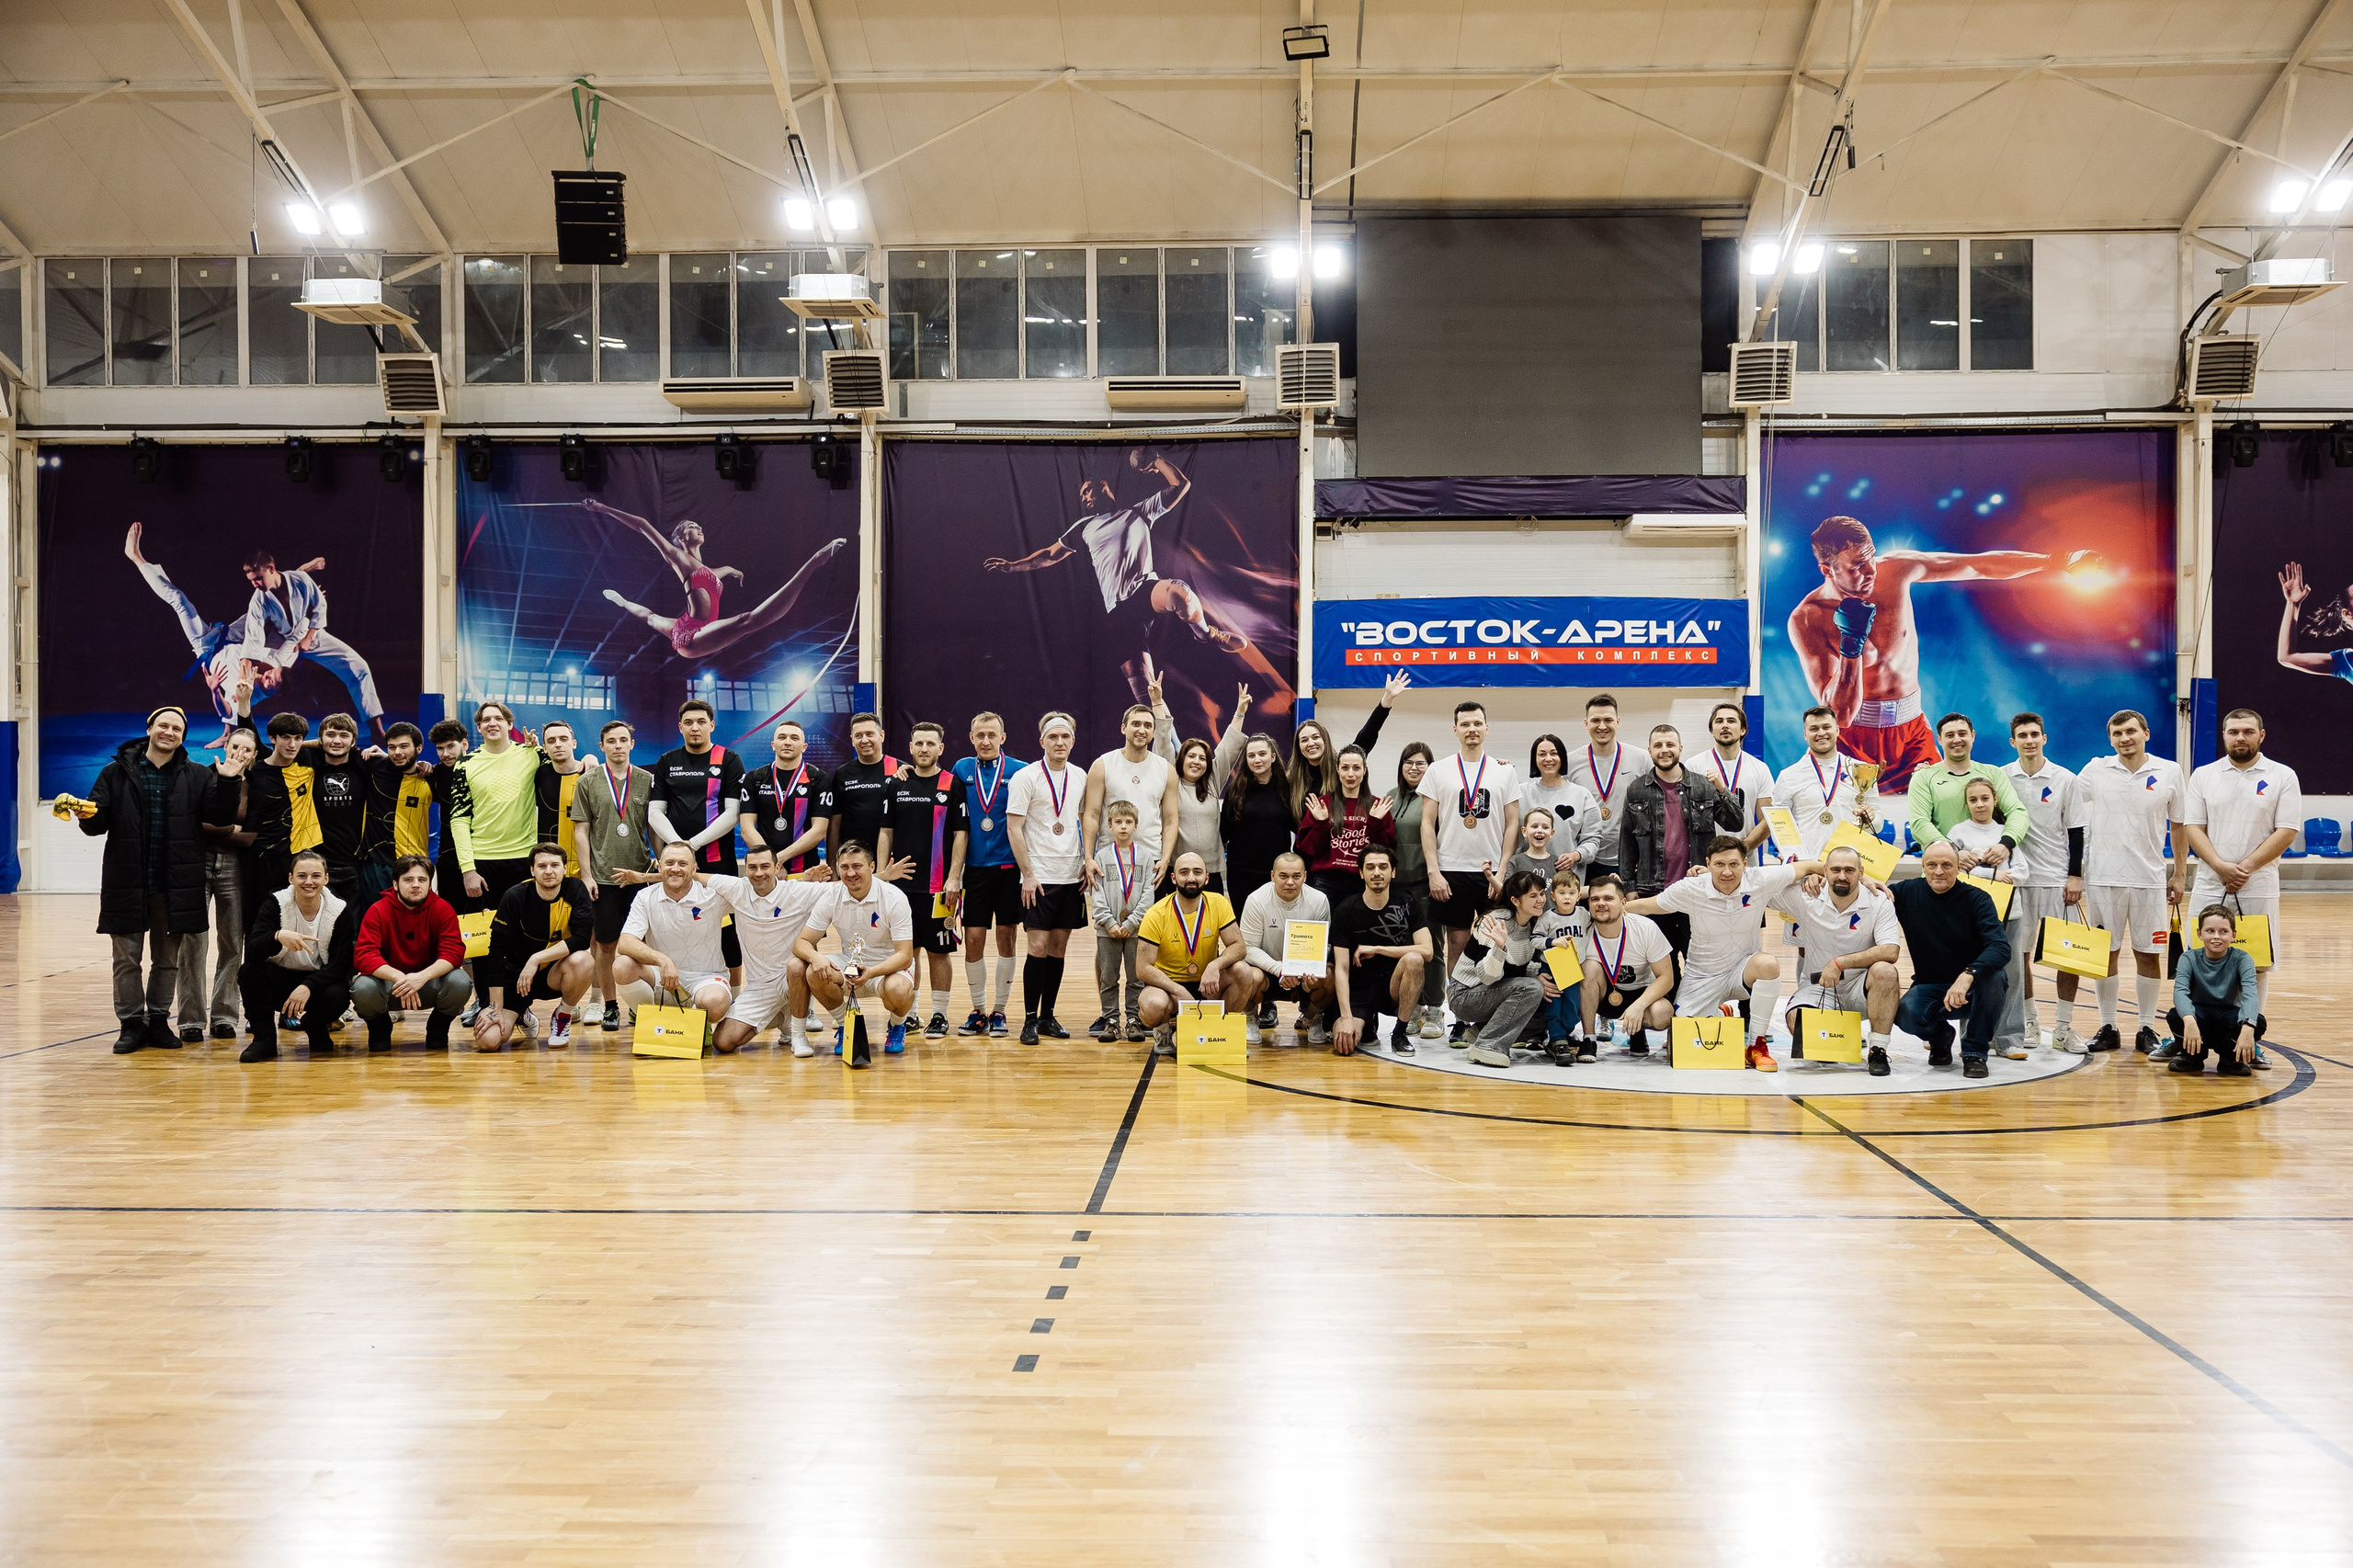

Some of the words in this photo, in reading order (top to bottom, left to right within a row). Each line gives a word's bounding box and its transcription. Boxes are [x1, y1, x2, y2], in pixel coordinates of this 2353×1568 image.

[1341, 619, 1722, 645] "ВОСТОК-АРЕНА"
[1355, 649, 1539, 662] СПОРТИВНЫЙ
[1578, 651, 1709, 660] КОМПЛЕКС
[819, 791, 833, 806] 10
[937, 930, 949, 946] 11
[1556, 926, 1583, 937] GOAL
